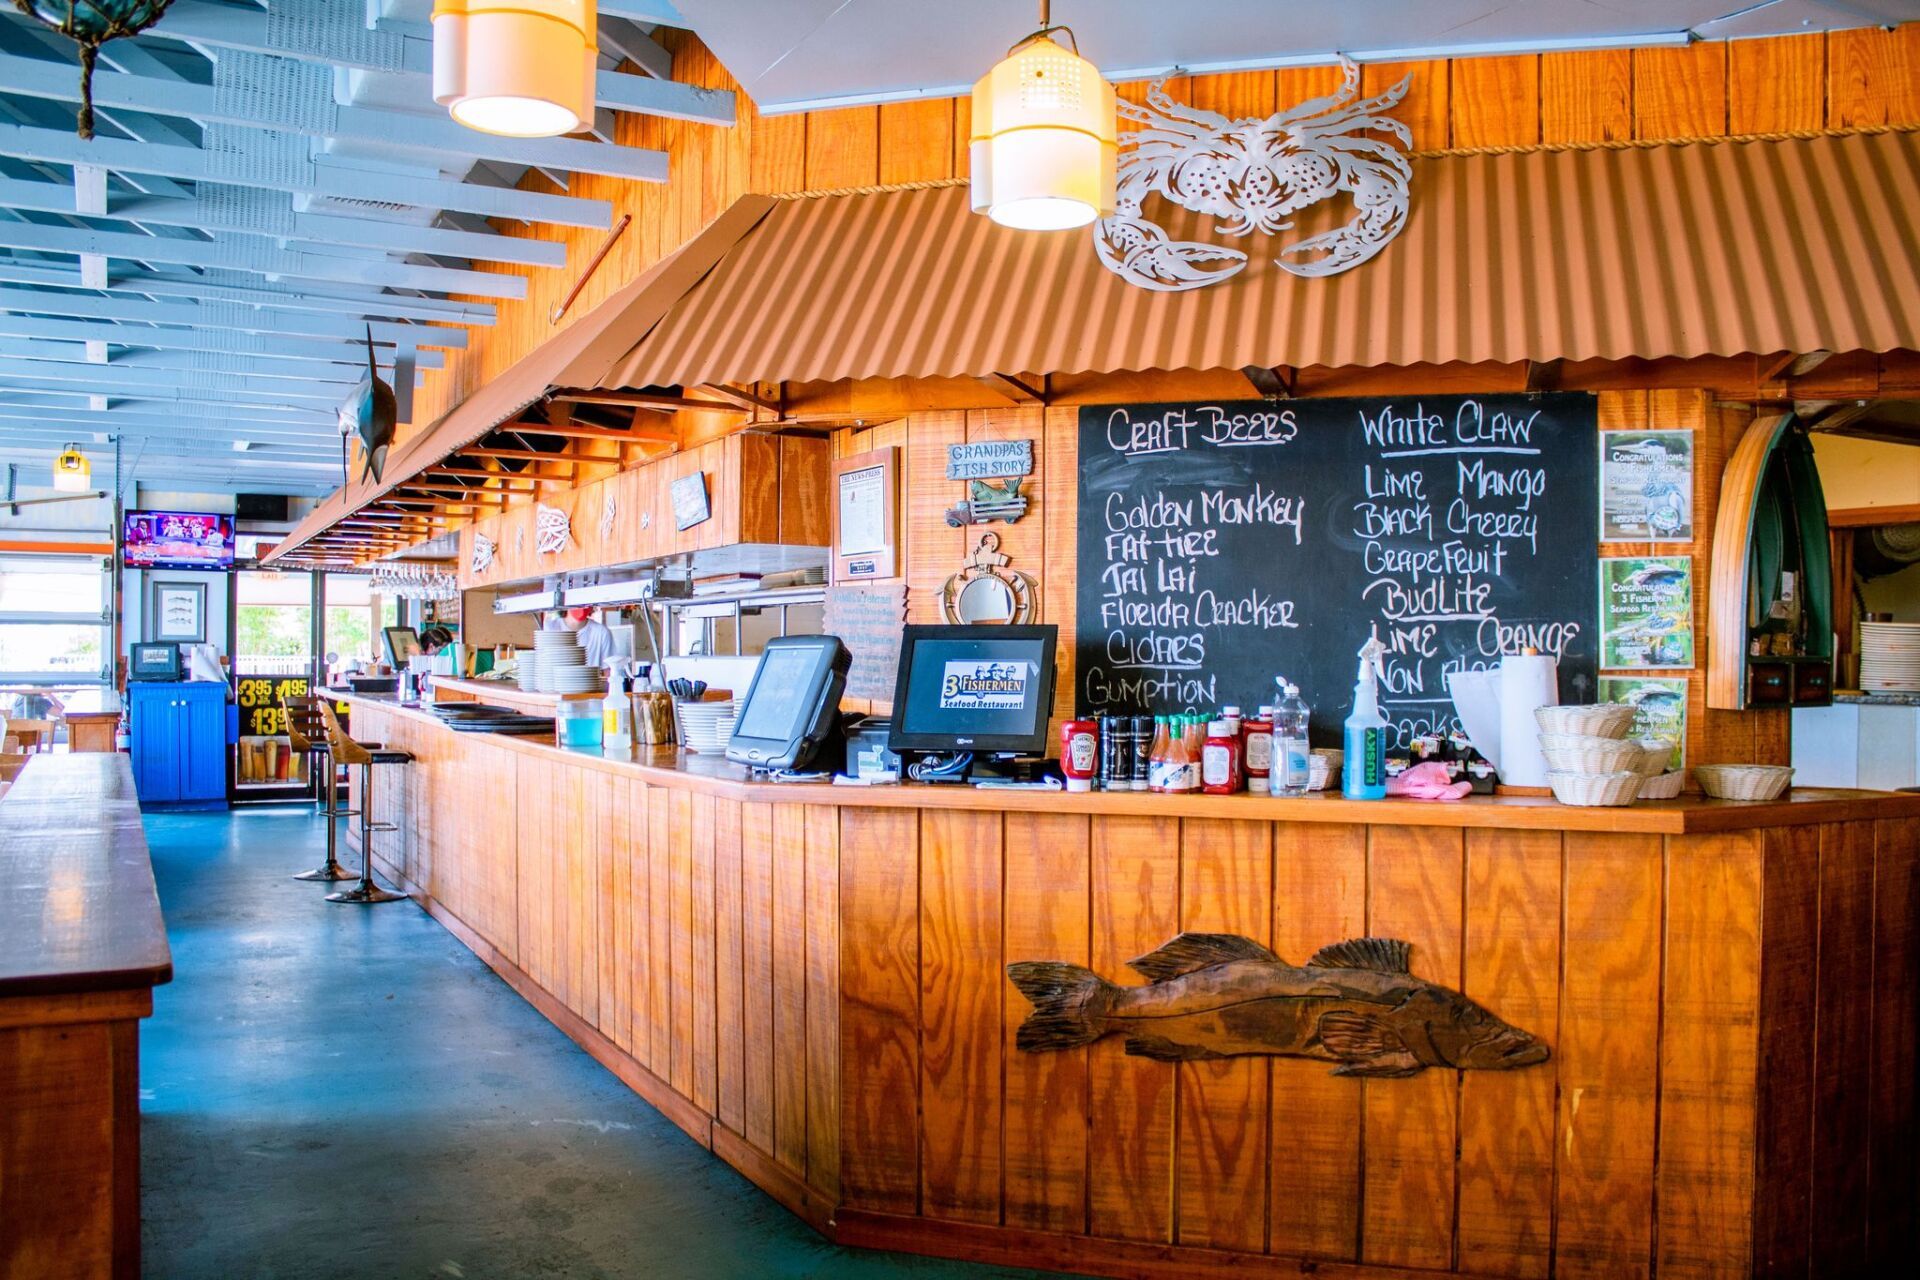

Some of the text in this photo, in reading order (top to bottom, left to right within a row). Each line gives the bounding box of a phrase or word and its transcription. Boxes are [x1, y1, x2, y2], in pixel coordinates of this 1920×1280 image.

[952, 459, 1026, 477] FISH STORY
[1611, 583, 1682, 593] CONGRATULATIONS
[1621, 593, 1673, 603] 3 FISHERMEN
[1610, 604, 1640, 613] SEAFOOD
[944, 674, 1022, 699] 3 FISHERMEN
[944, 700, 1022, 708] Seafood Restaurant
[1366, 729, 1376, 784] HUSKY
